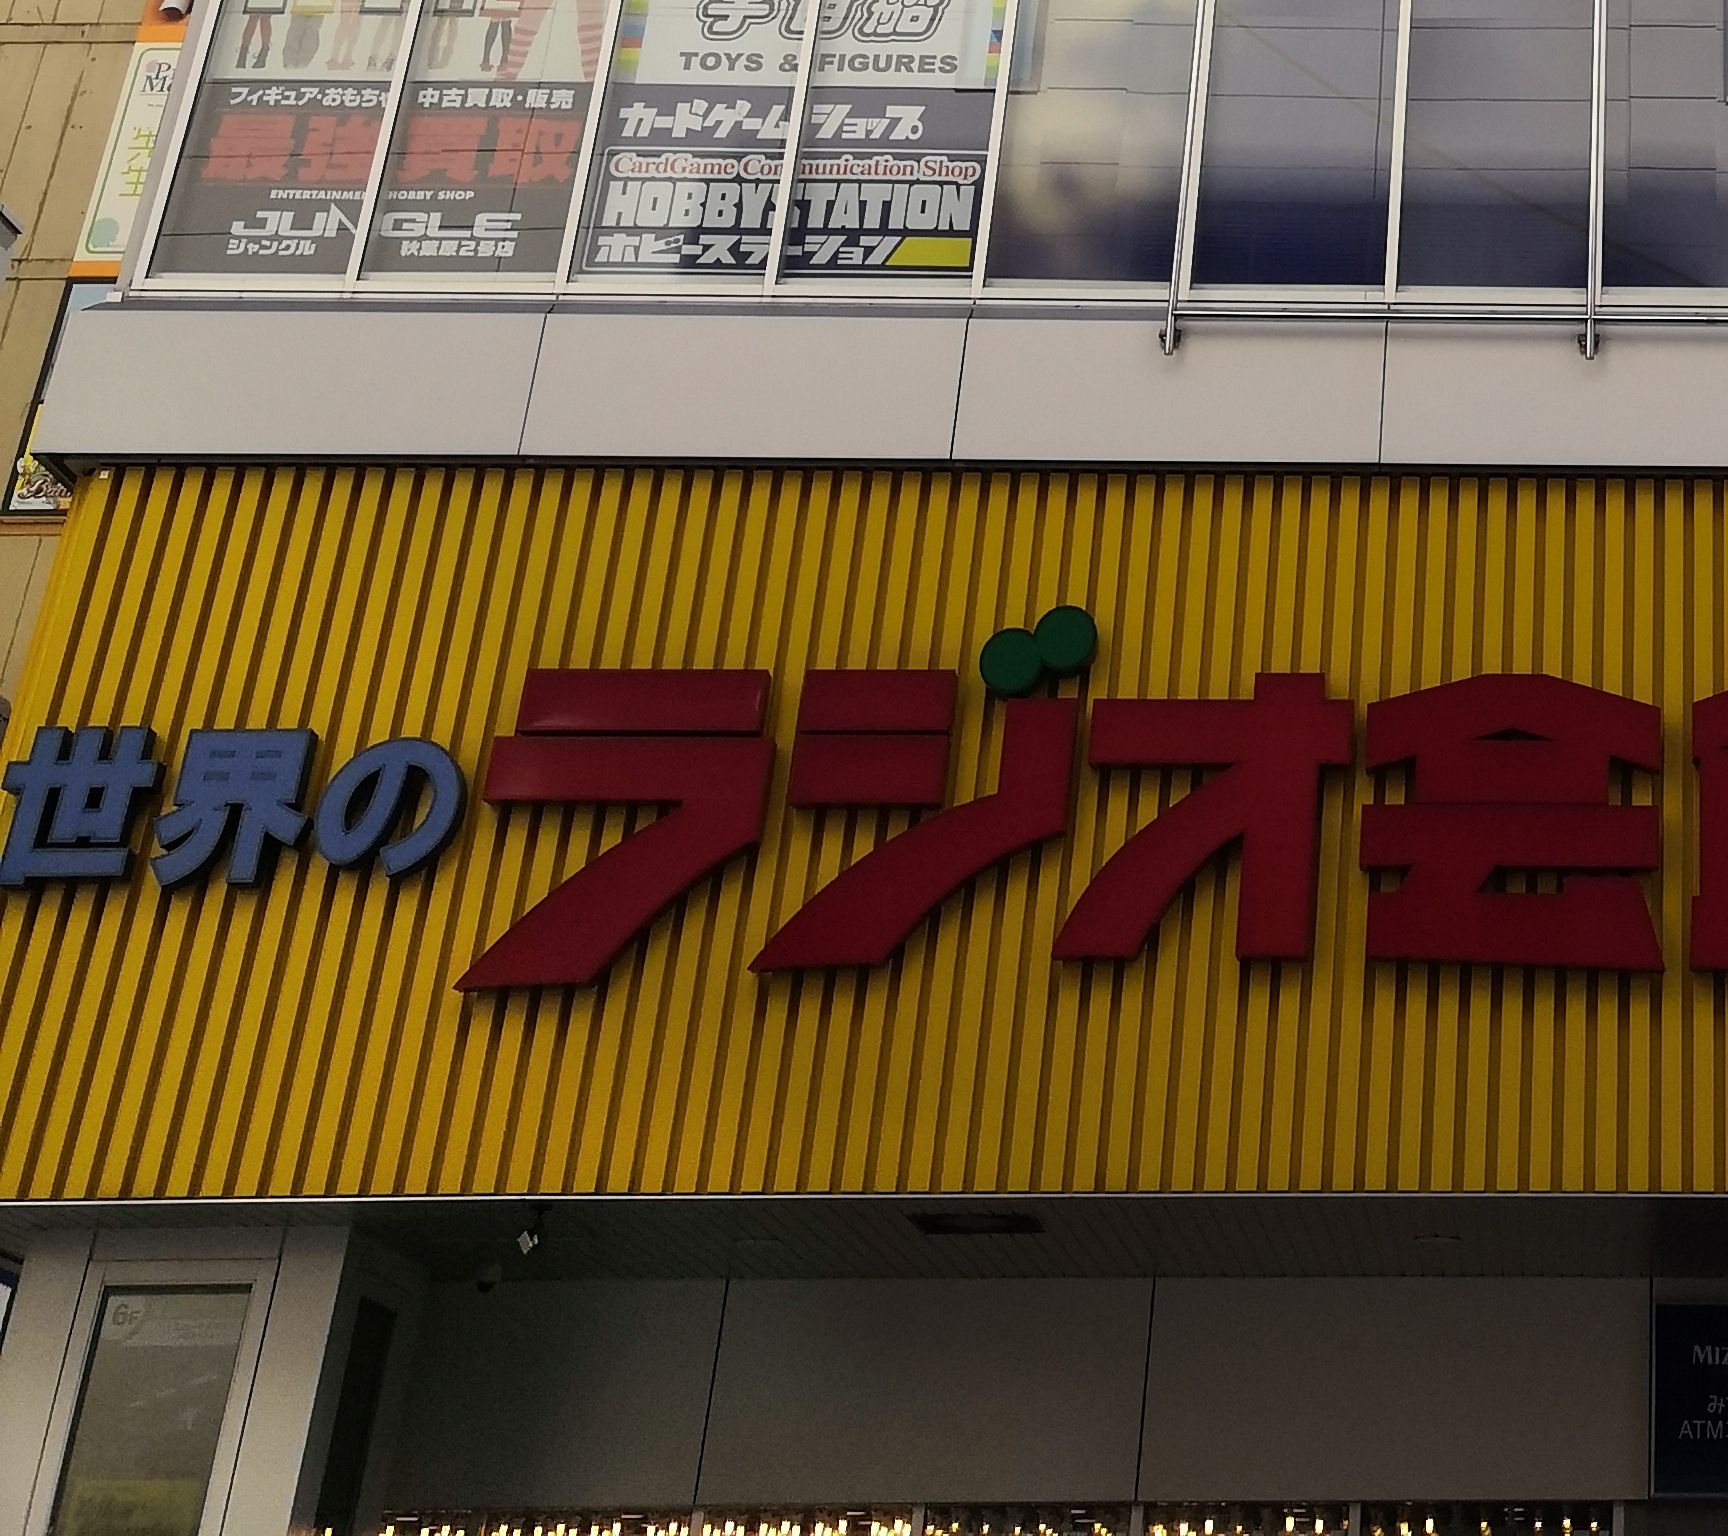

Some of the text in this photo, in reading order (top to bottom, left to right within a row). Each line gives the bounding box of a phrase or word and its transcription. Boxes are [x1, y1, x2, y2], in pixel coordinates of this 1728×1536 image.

[679, 51, 764, 74] TOYS
[818, 52, 959, 75] FIGURES
[612, 153, 736, 179] CardGame
[922, 157, 979, 182] Shop
[270, 188, 367, 201] ENTERTAINME
[437, 188, 475, 201] SHOP
[226, 237, 317, 257] ジャングル
[0, 724, 466, 892] 世界の
